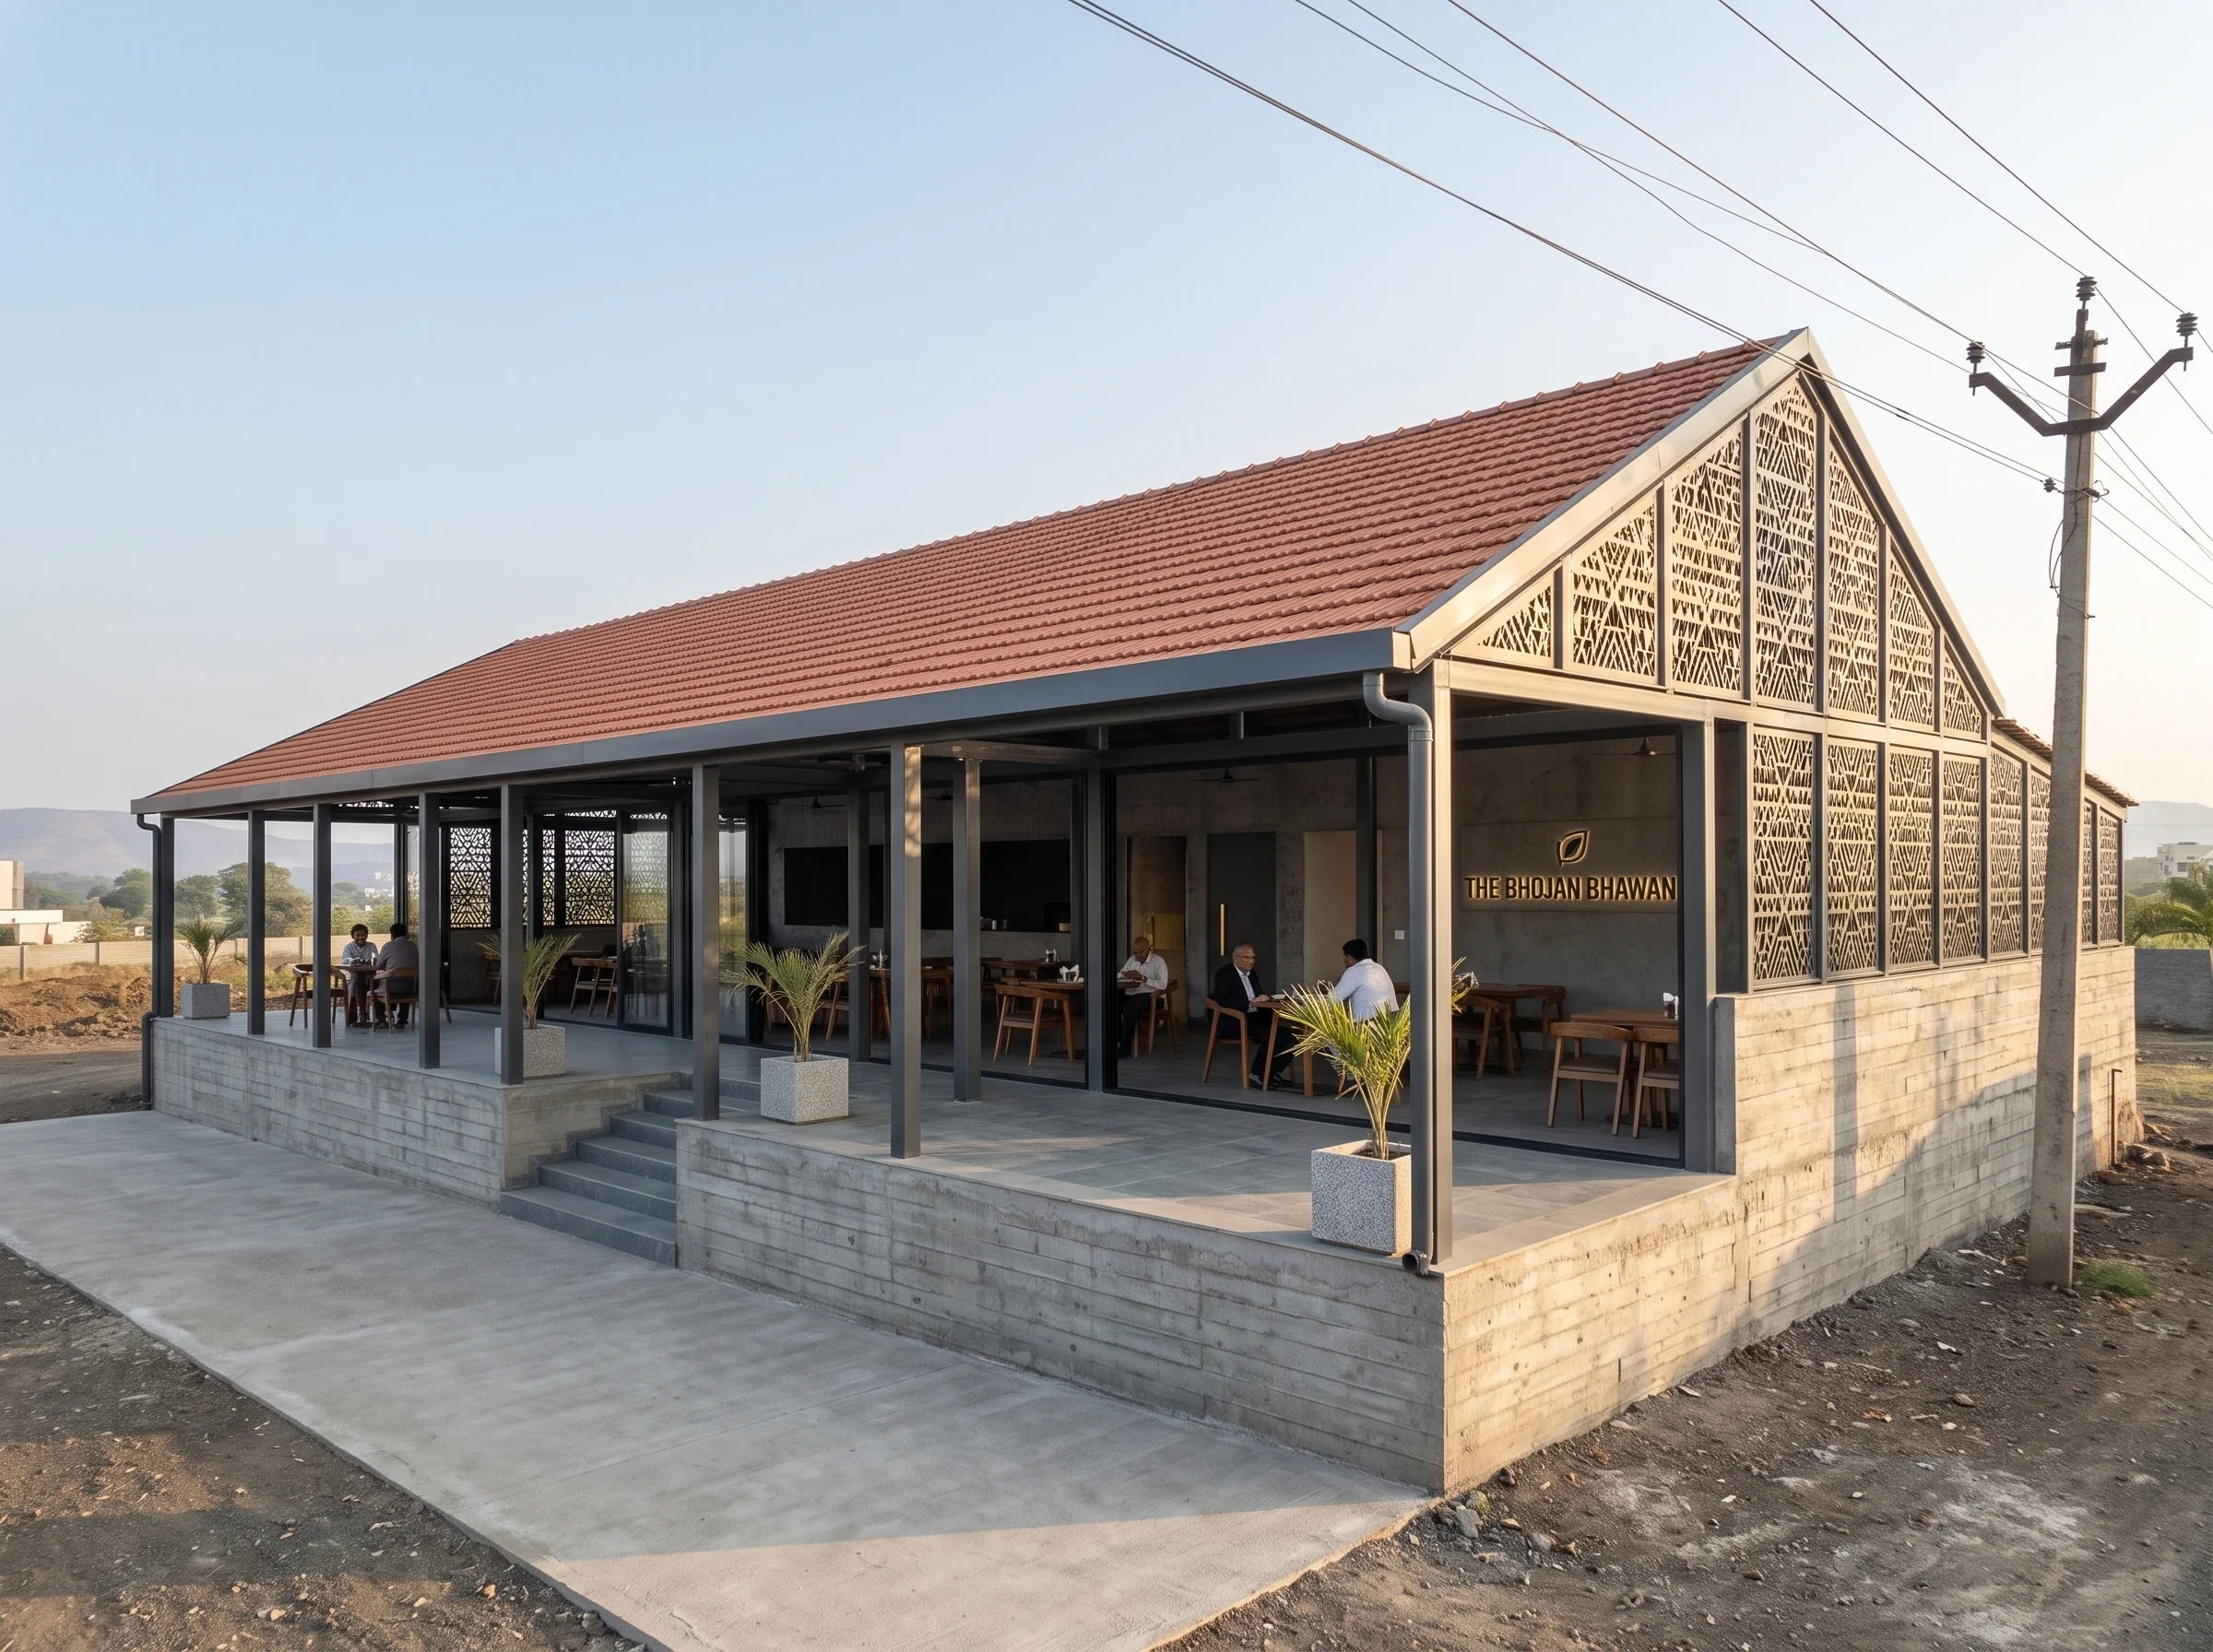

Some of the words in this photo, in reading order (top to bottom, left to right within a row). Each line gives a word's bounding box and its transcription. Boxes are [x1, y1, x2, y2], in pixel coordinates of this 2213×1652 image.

[1464, 877, 1500, 899] THE
[1505, 877, 1580, 900] BHOJAN
[1586, 877, 1676, 901] BHAWAN
